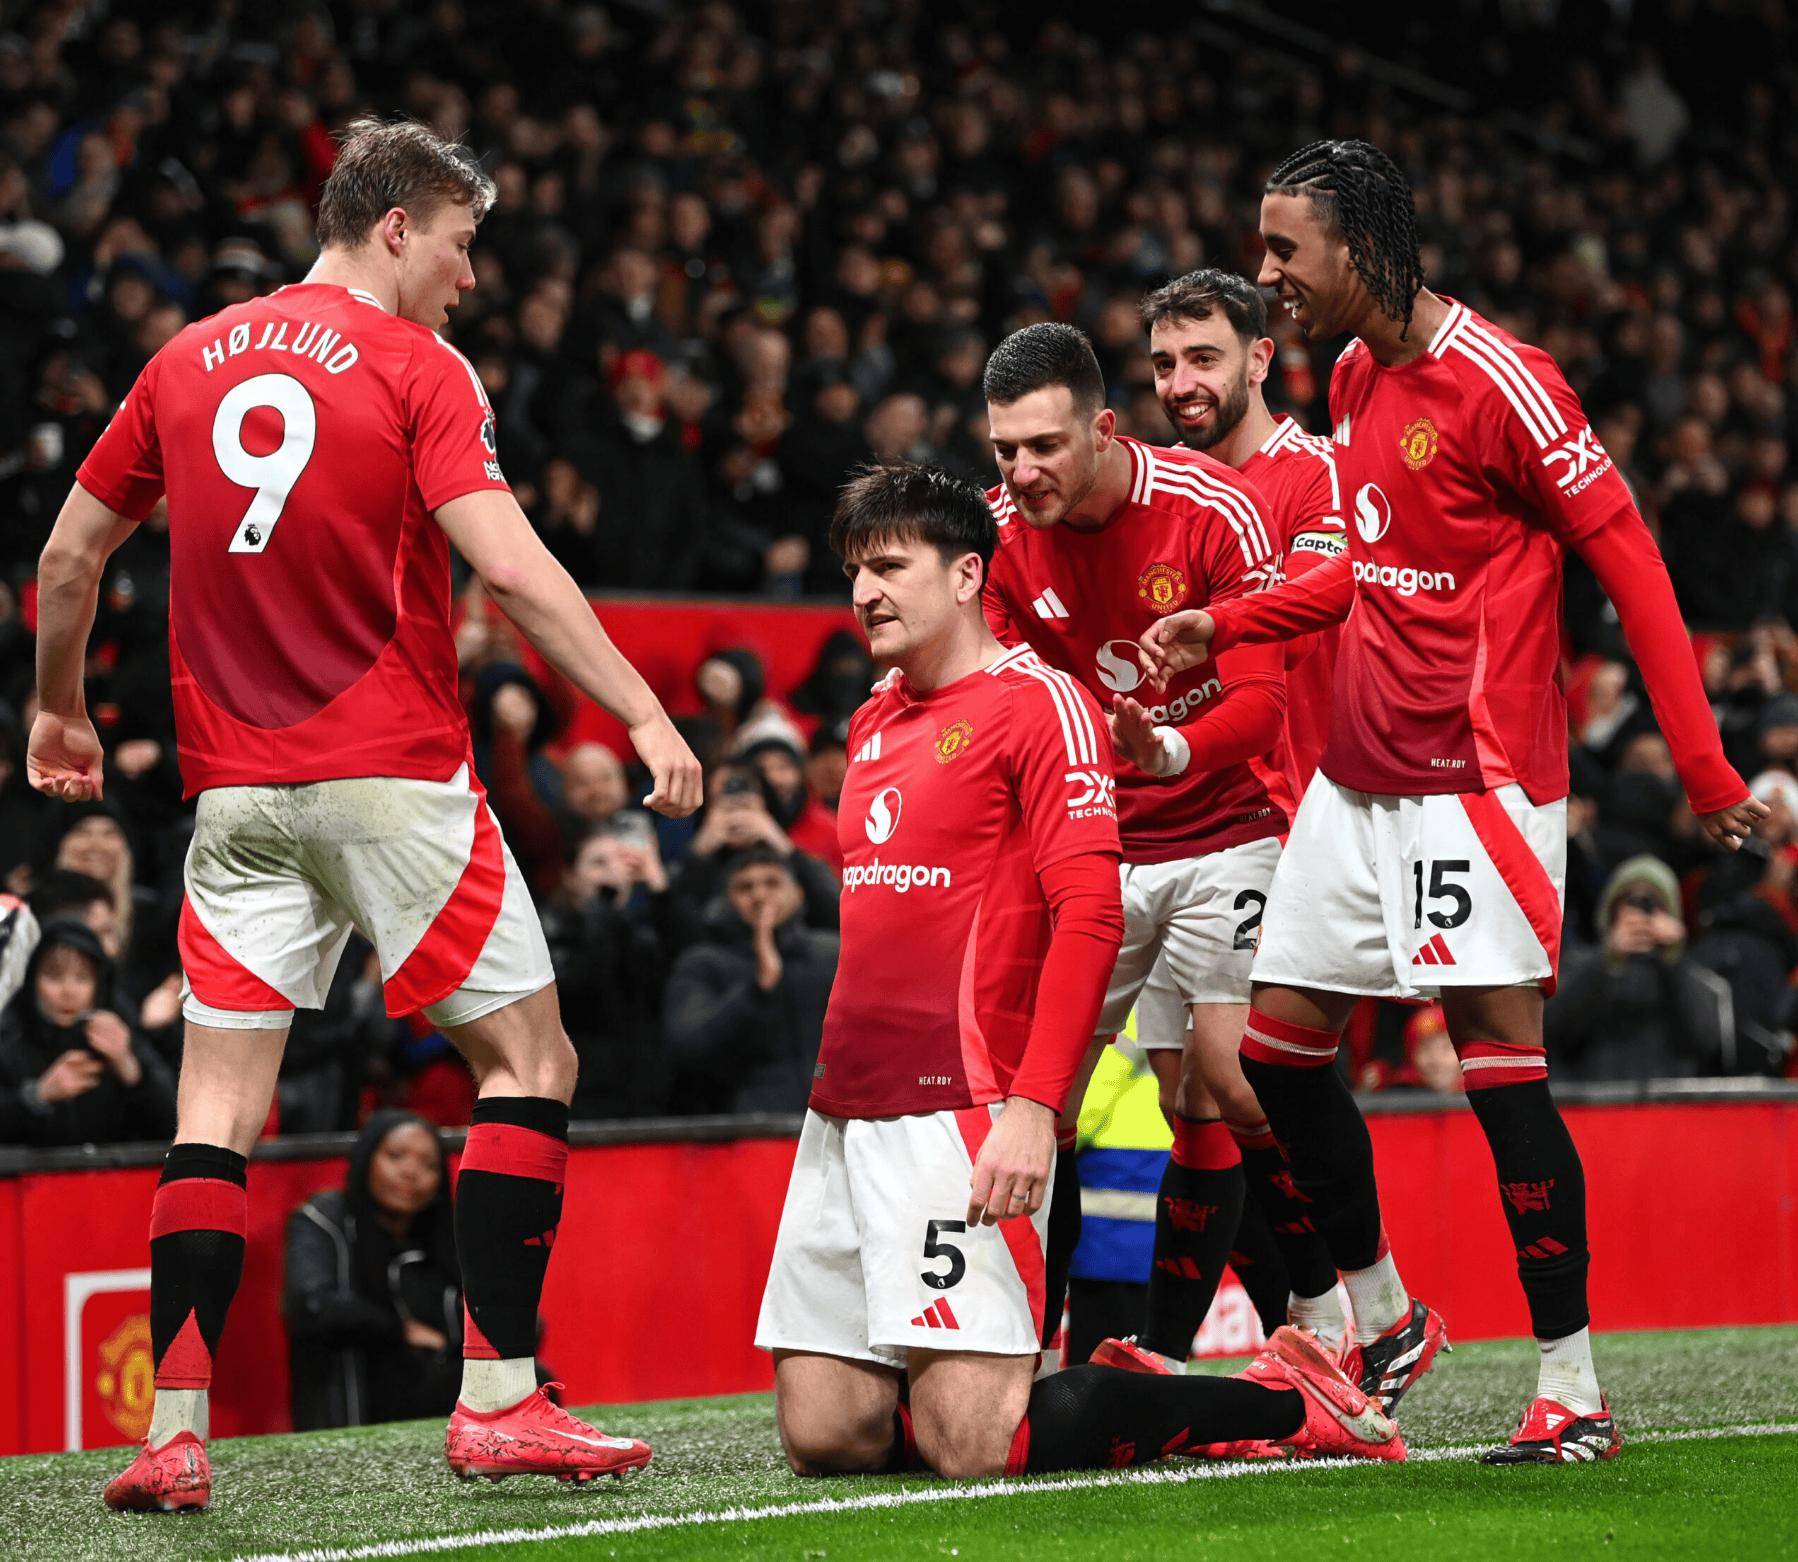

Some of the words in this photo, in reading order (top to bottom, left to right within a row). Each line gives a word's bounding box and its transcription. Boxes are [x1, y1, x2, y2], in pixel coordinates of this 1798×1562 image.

[202, 321, 360, 376] HØJLUND
[212, 372, 317, 553] 9
[1144, 678, 1222, 723] agon
[1431, 758, 1466, 769] HEAT.RDY
[1414, 859, 1473, 930] 15
[919, 1076, 952, 1085] HEAT.RDY
[920, 1219, 967, 1290] 5
